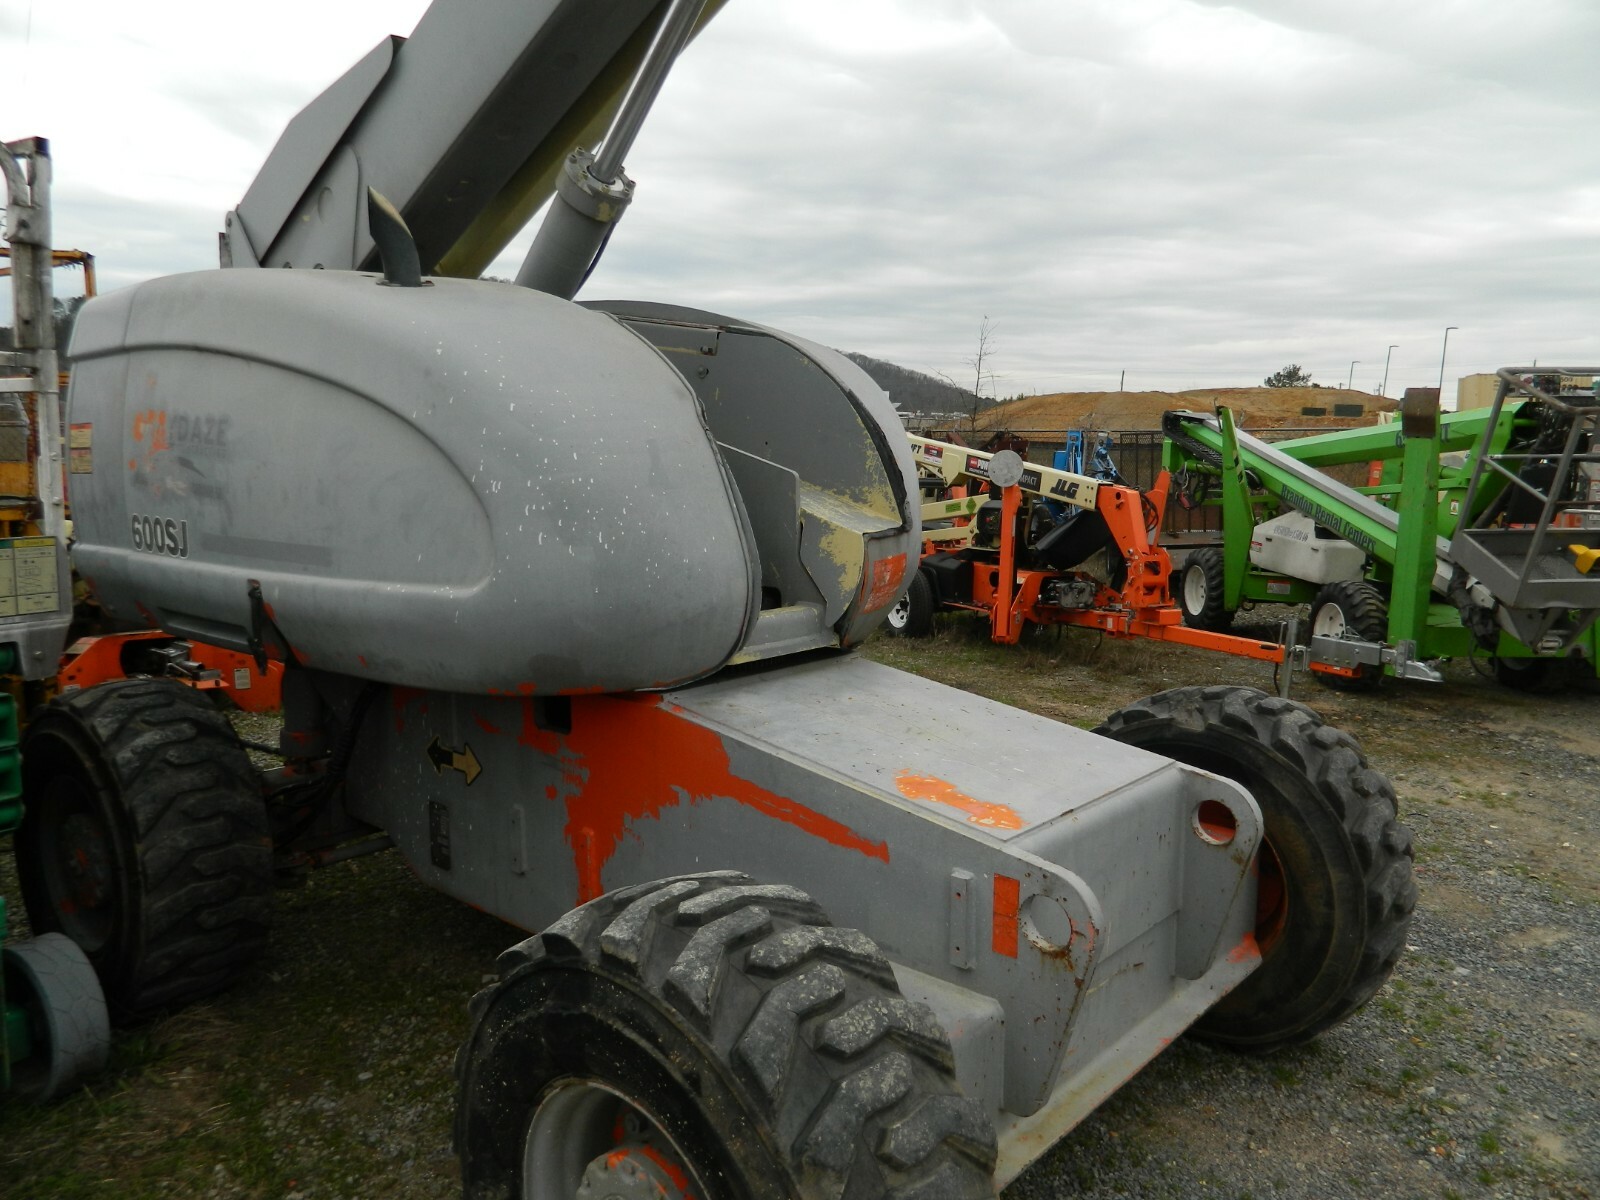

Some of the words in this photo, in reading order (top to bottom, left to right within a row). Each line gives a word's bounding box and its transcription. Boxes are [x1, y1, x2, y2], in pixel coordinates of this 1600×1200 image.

[1050, 478, 1080, 500] JLG
[131, 513, 188, 559] 600SJ
[1281, 484, 1314, 513] Brandon
[1315, 504, 1342, 533] Rental
[1343, 521, 1377, 554] Centers
